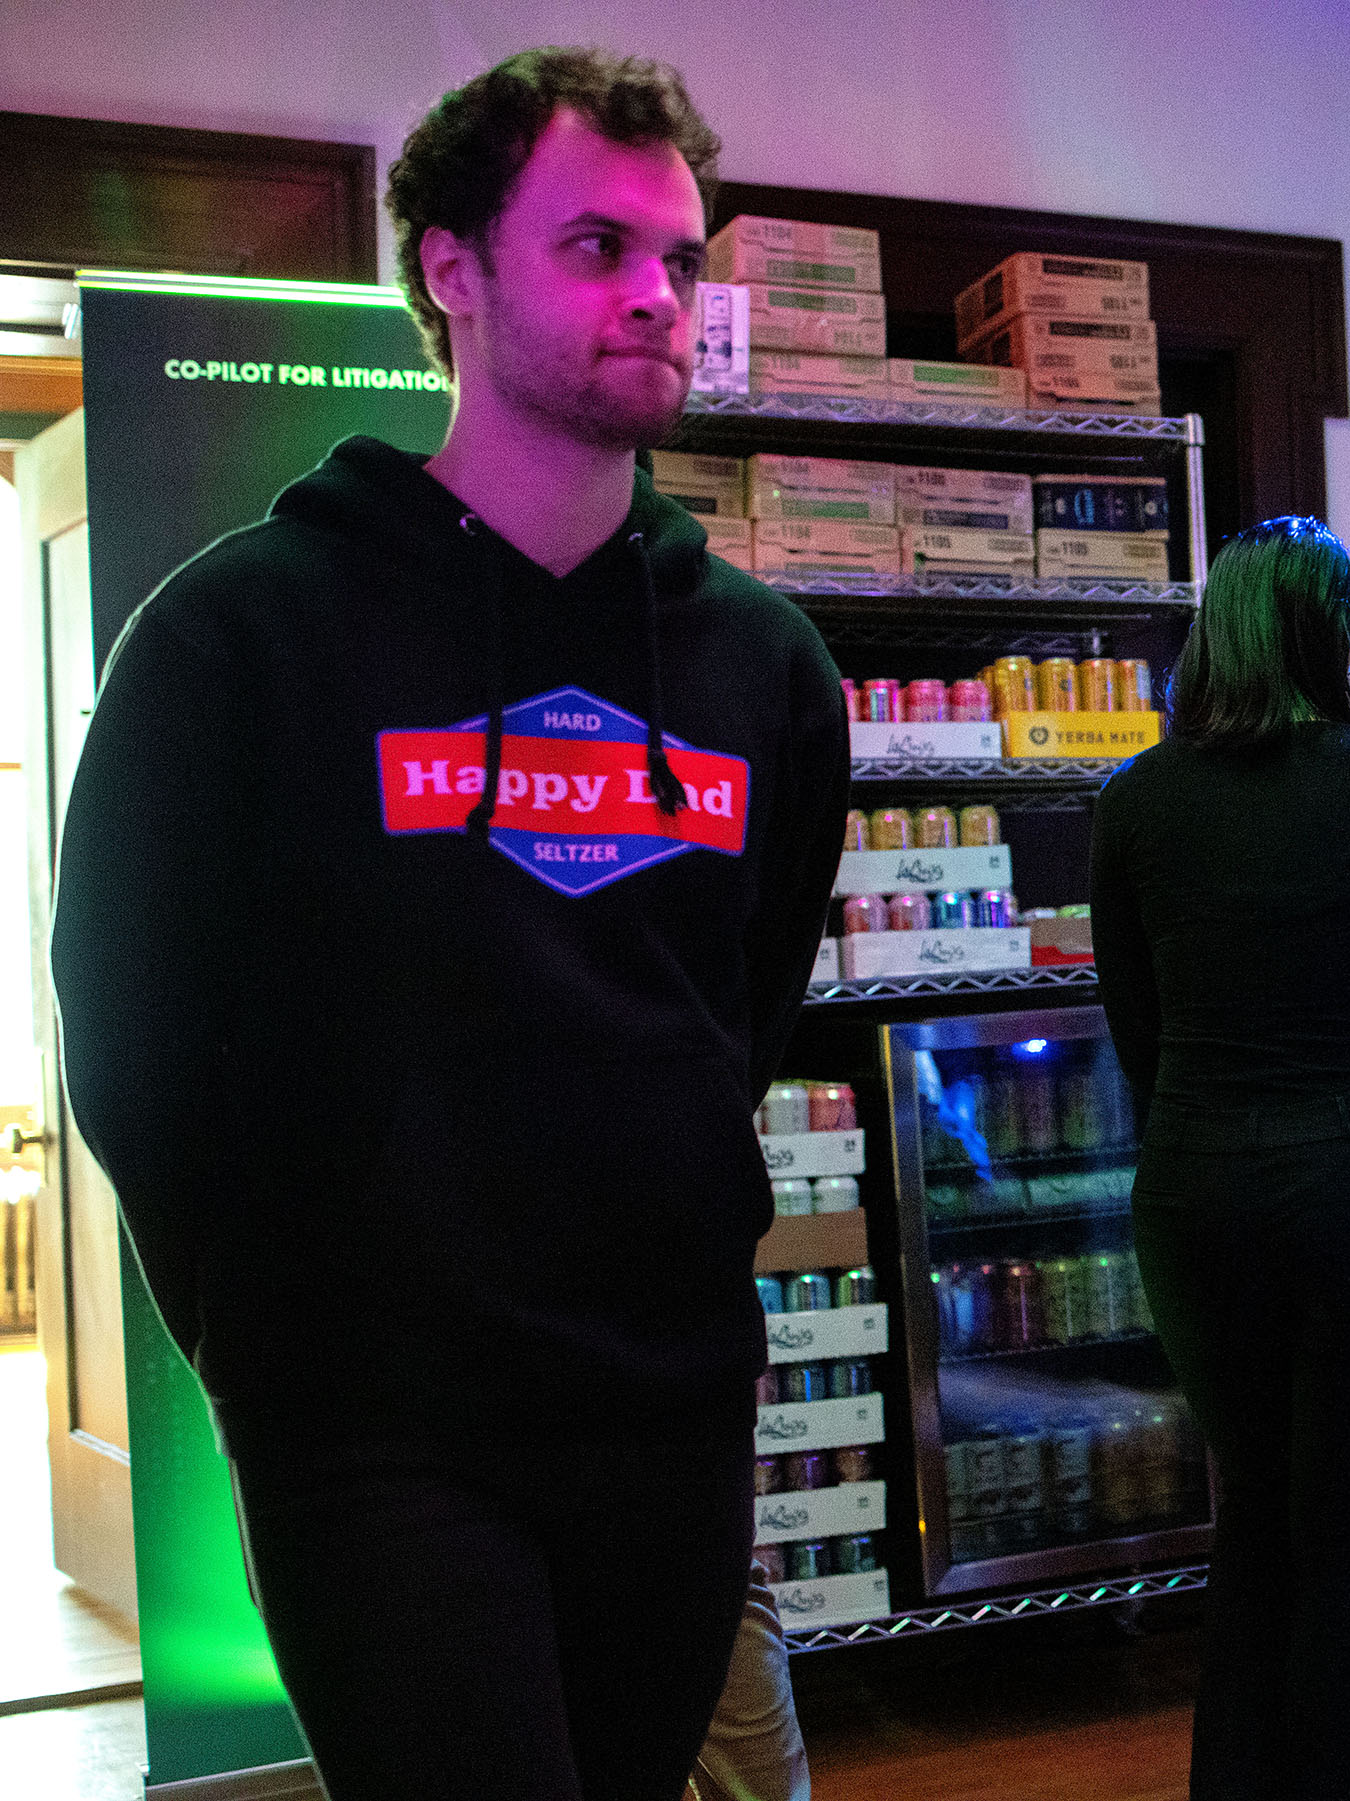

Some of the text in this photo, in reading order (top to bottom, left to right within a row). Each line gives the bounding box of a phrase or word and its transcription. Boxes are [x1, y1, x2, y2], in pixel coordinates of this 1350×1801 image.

[164, 358, 273, 384] CO-PILOT
[278, 364, 326, 386] FOR
[543, 710, 601, 731] HARD
[1056, 731, 1145, 745] YERBA MATE
[402, 759, 609, 813] Happy
[533, 841, 619, 863] SELTZER
